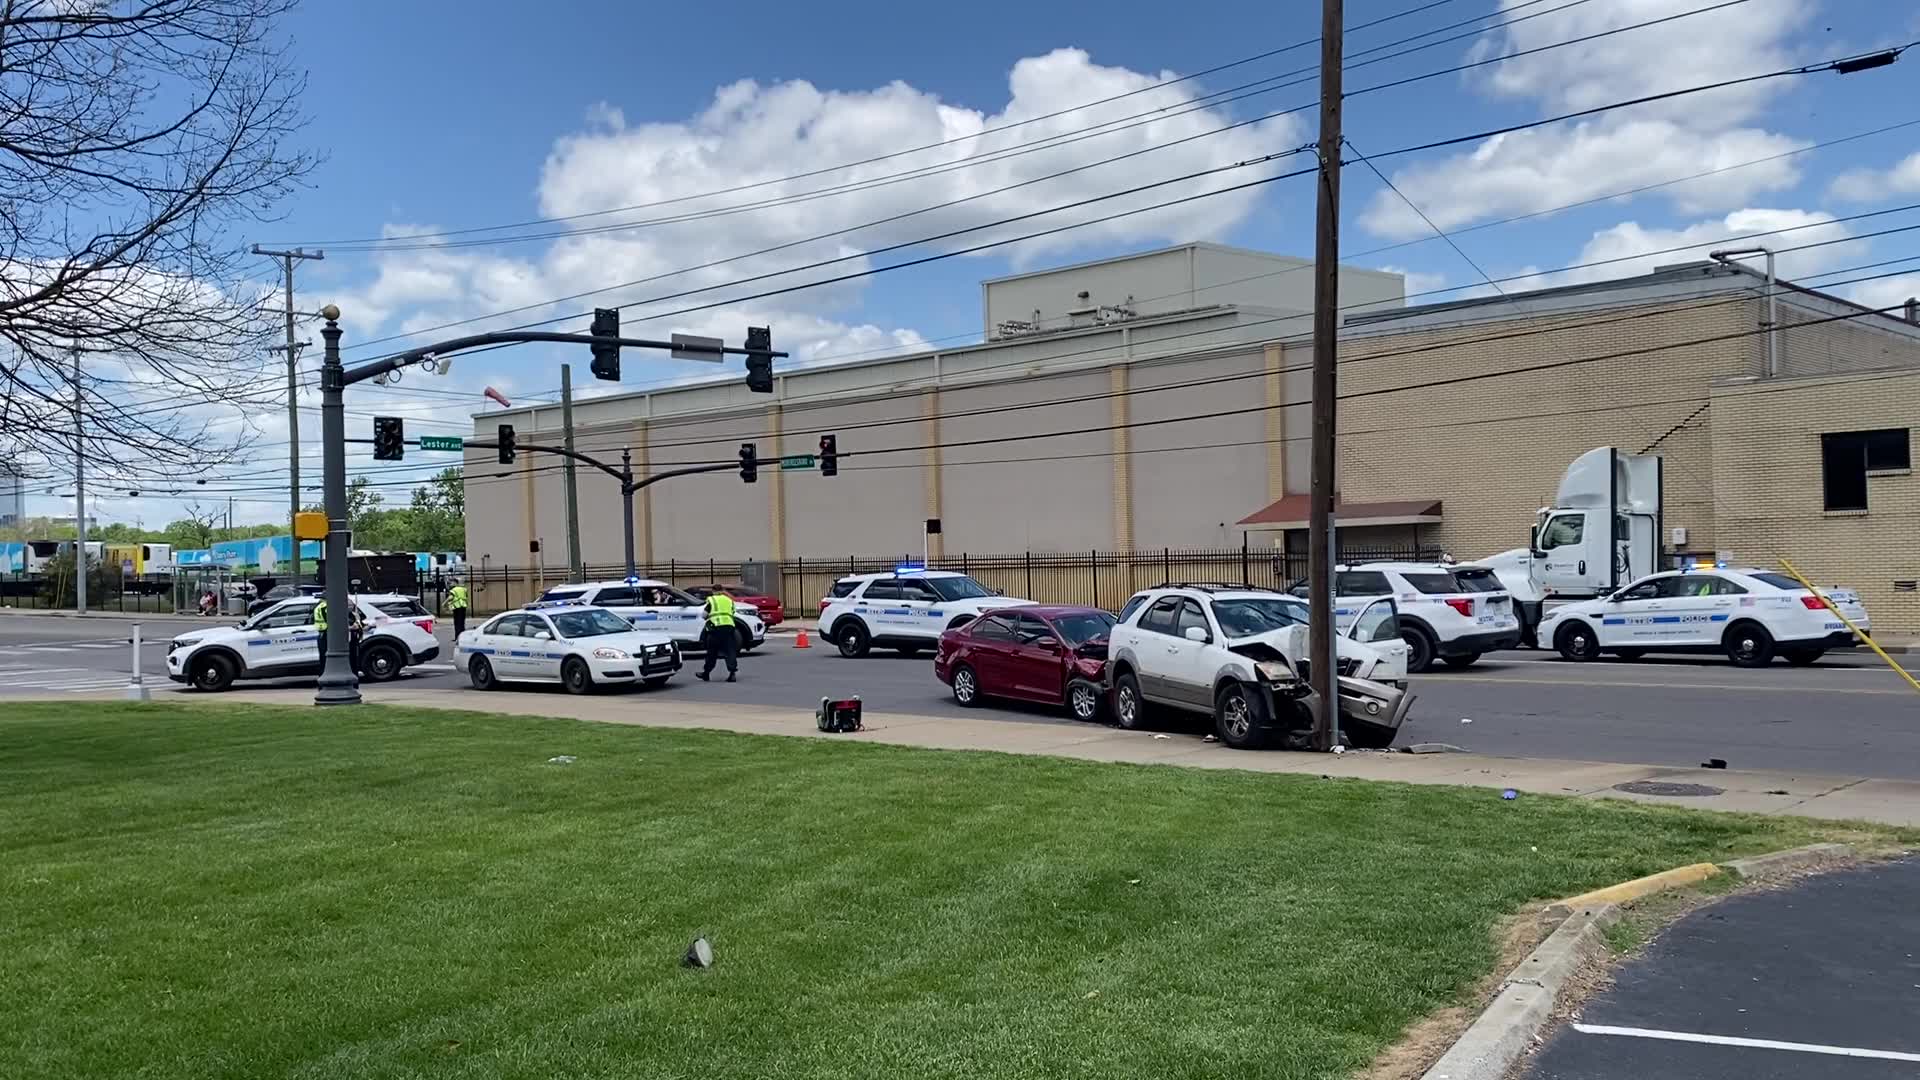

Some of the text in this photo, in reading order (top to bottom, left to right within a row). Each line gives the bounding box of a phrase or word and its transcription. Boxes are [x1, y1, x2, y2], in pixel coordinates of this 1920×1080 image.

[421, 440, 449, 448] Lester
[908, 608, 928, 616] POLICE
[656, 613, 682, 621] POLICE
[1680, 614, 1711, 623] POLICE
